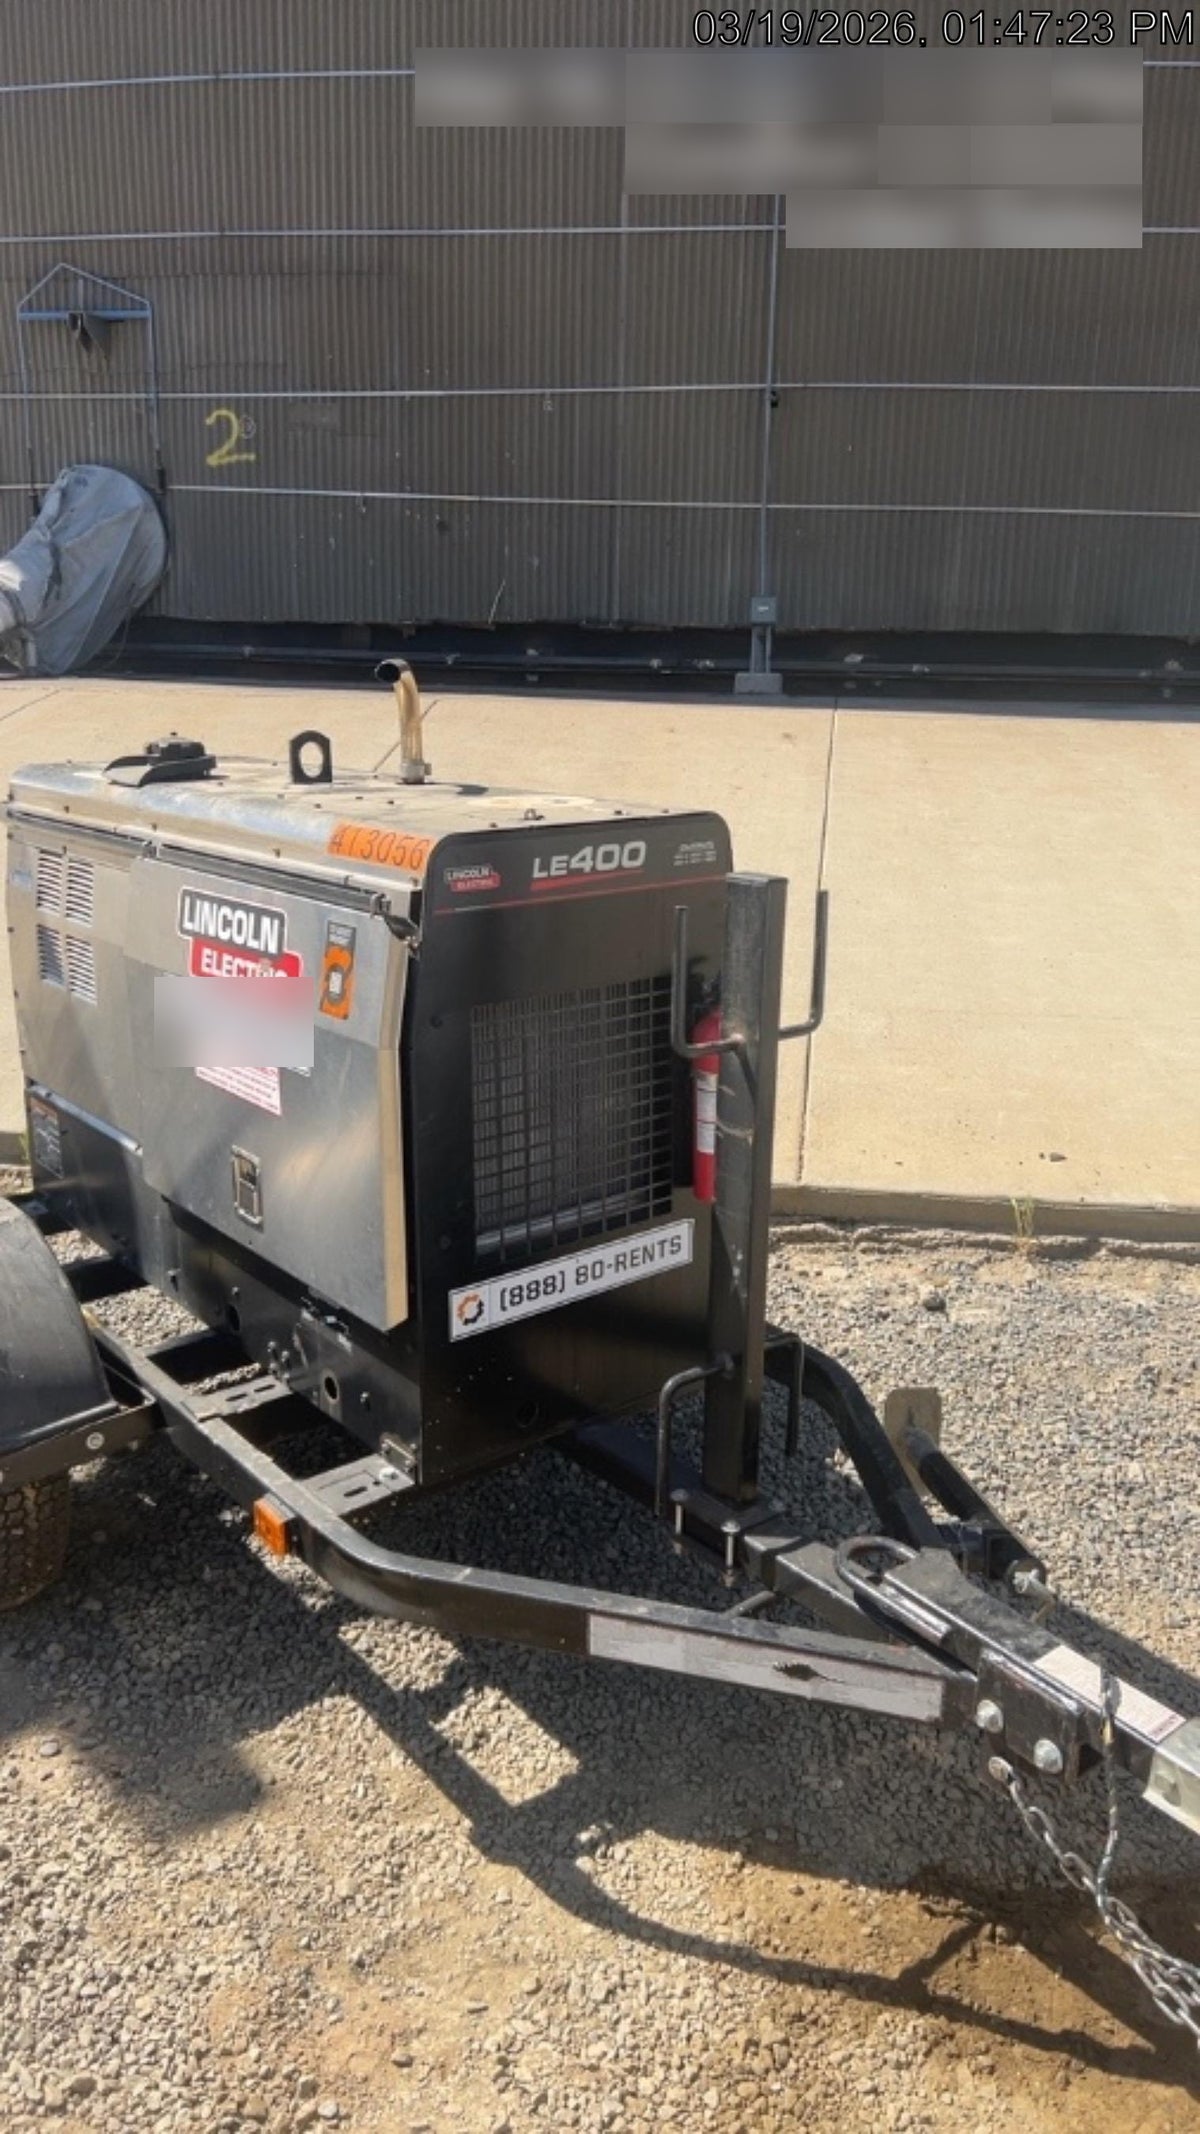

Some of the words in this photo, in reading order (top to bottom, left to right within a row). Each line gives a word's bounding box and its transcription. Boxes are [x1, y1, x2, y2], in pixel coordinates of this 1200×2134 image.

[205, 408, 256, 466] 2
[532, 841, 647, 879] LE400
[182, 895, 280, 955] LINCOLN
[500, 1271, 566, 1312] (888)
